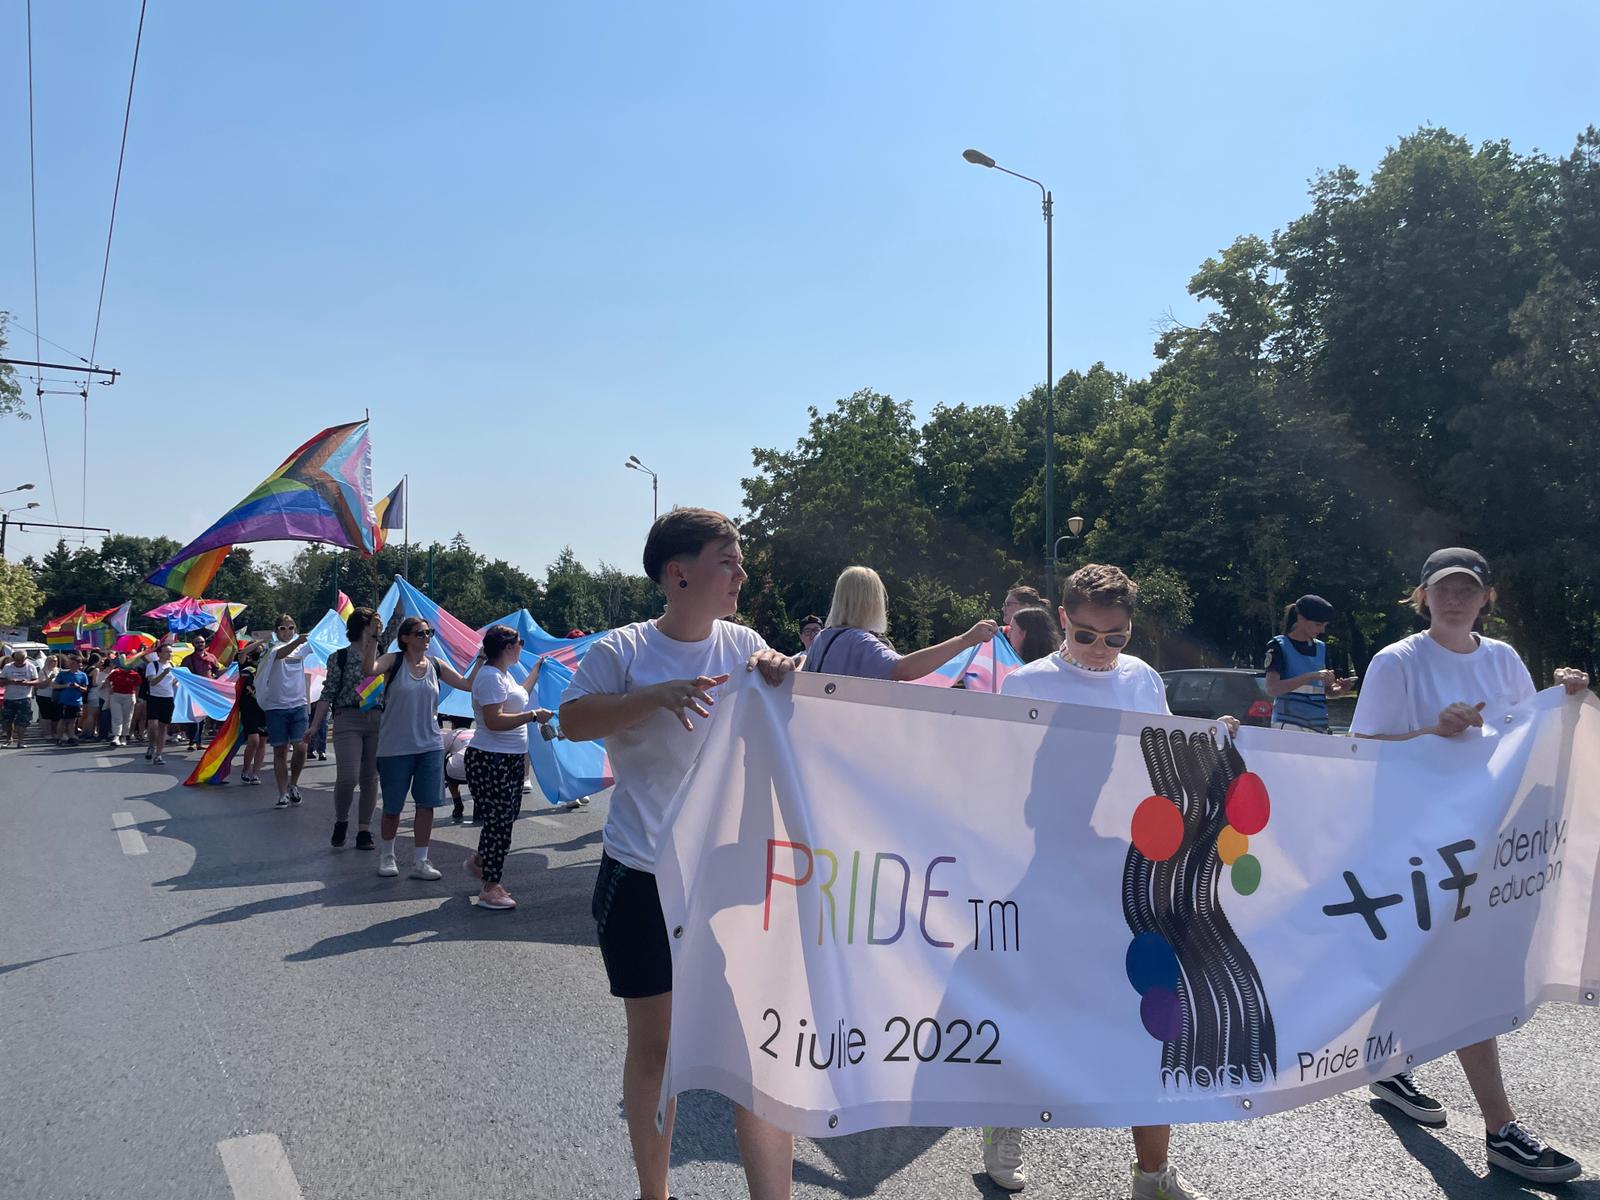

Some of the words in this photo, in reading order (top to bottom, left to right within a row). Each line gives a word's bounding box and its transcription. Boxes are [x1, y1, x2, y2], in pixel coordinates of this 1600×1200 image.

[763, 838, 957, 949] PRIDE
[759, 1007, 782, 1060] 2
[794, 1014, 867, 1070] iulie
[882, 1016, 1002, 1065] 2022
[1297, 1047, 1359, 1082] Pride
